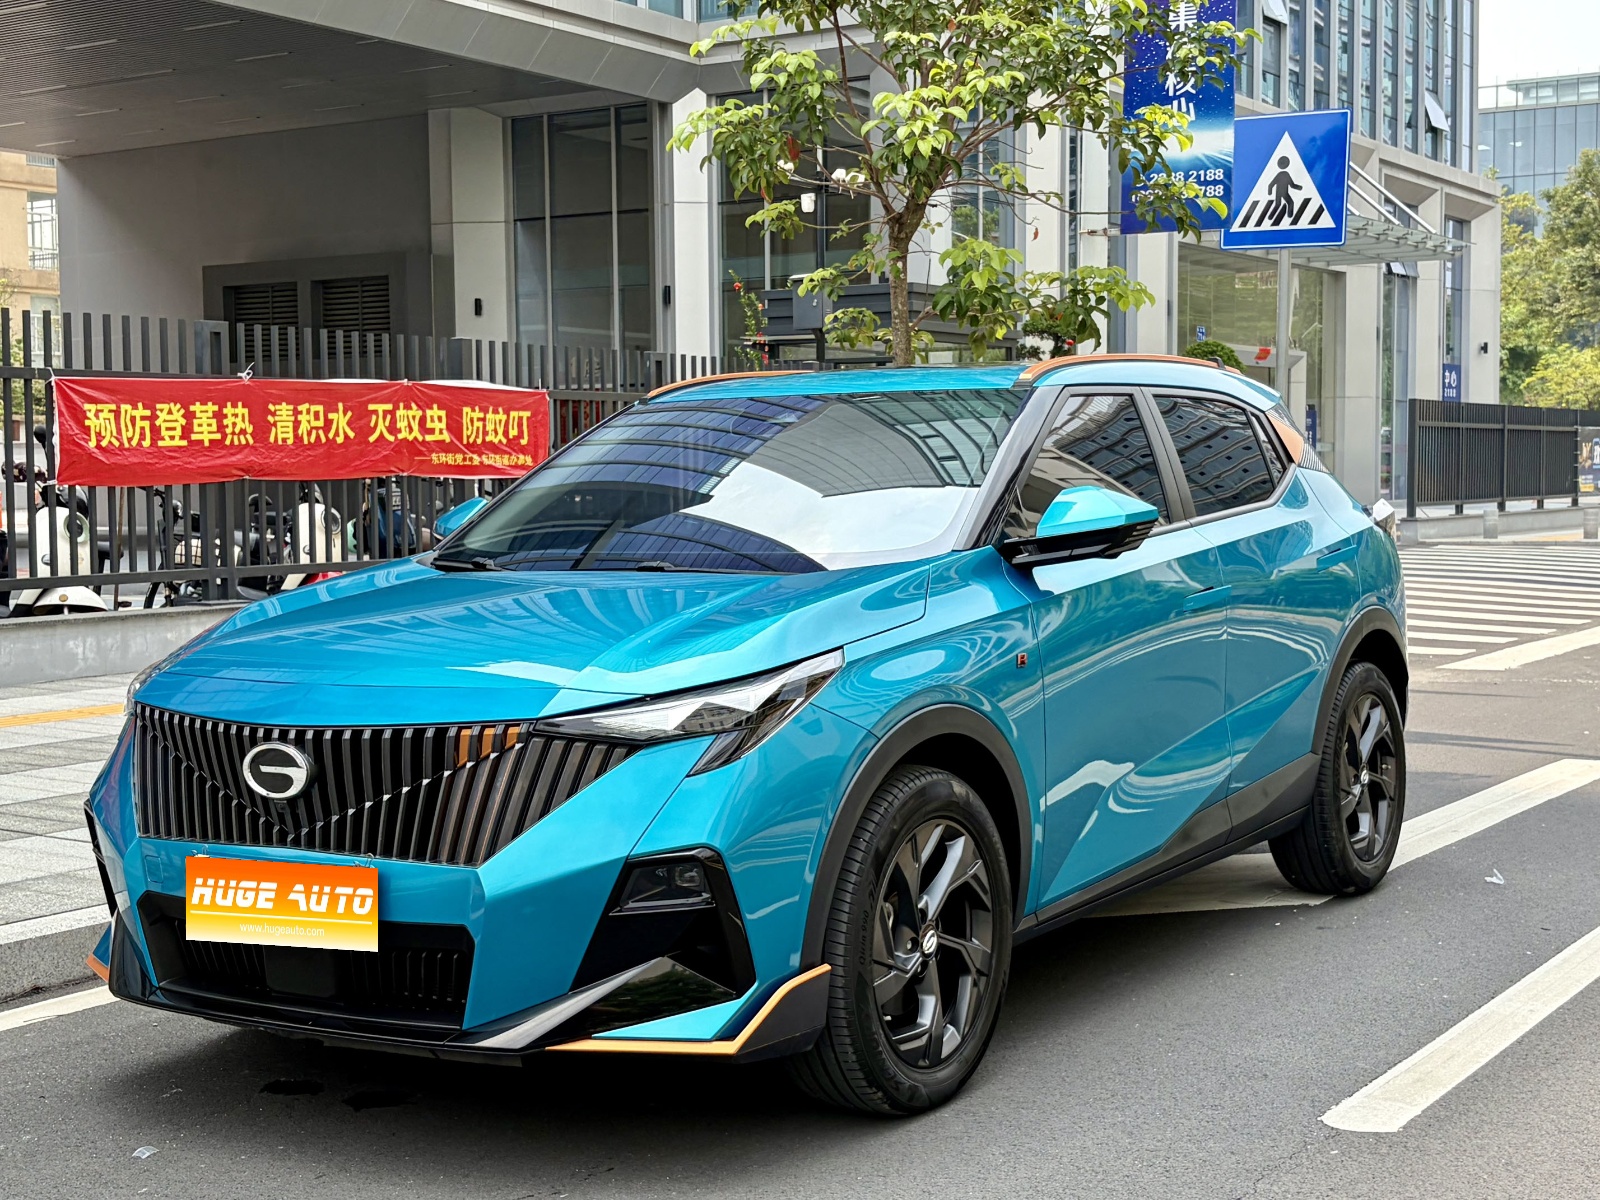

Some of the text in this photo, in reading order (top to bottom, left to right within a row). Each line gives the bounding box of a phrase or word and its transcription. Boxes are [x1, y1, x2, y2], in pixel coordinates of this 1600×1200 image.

[1188, 168, 1224, 183] 2188
[84, 402, 532, 448] 预防登革热 清积水 灭蚊虫 防蚊叮
